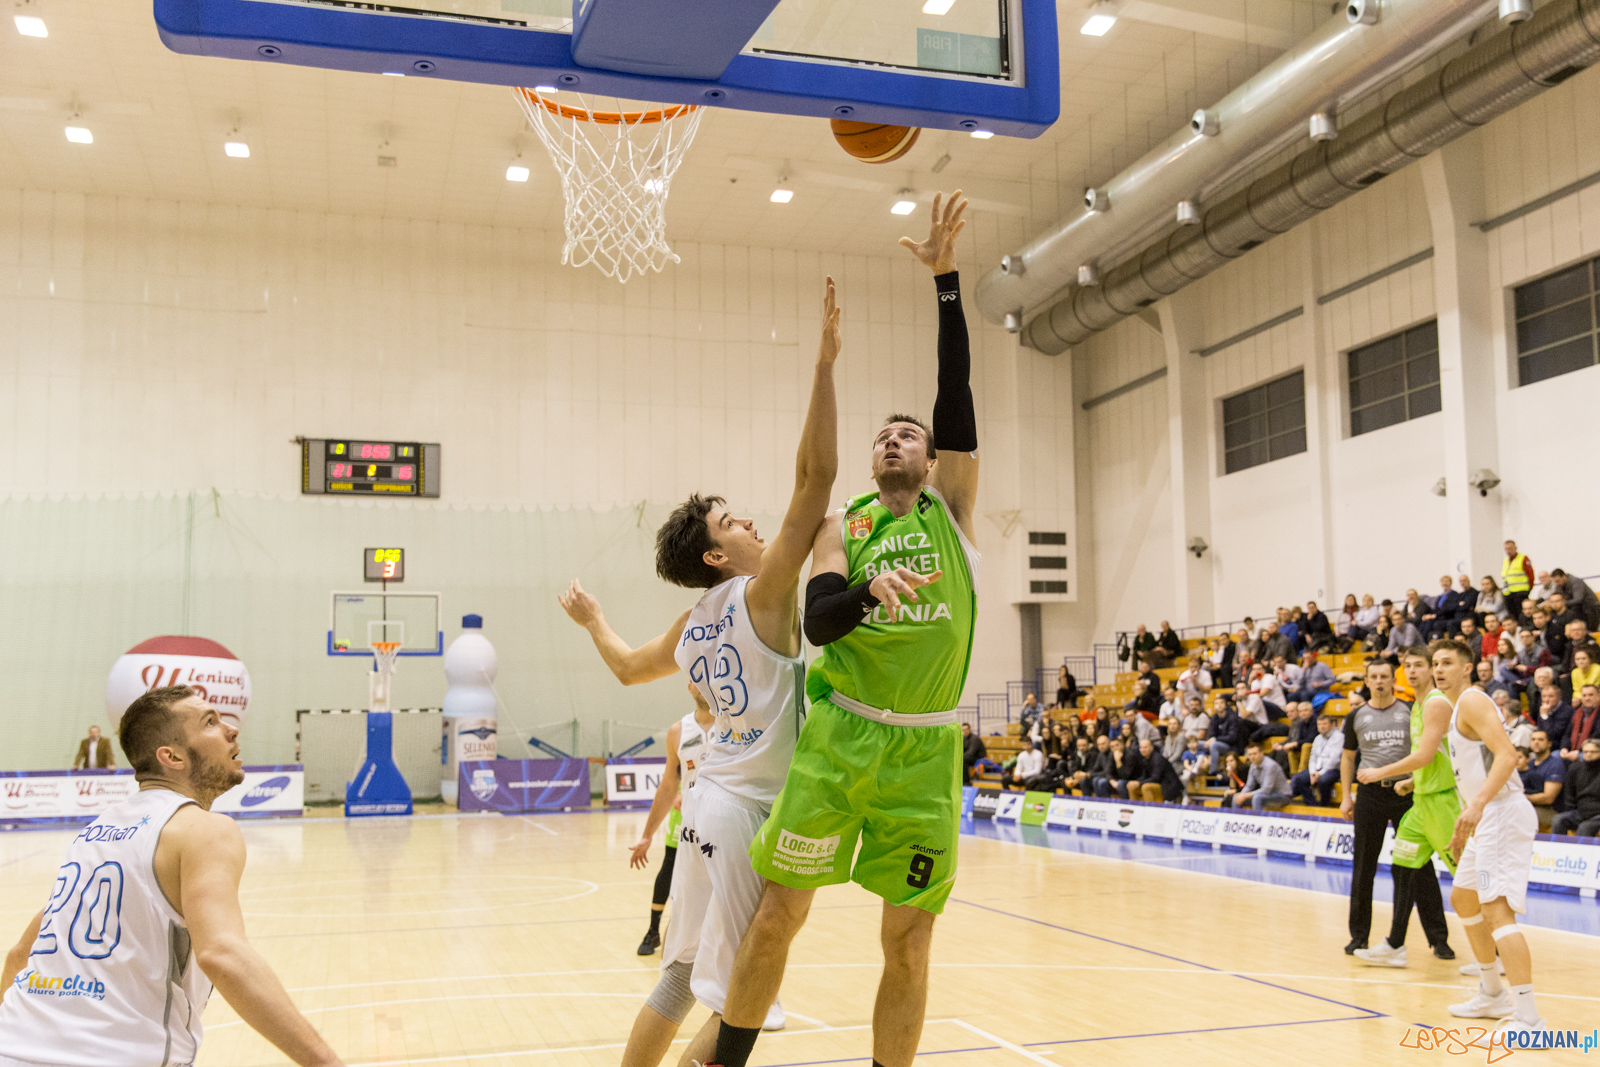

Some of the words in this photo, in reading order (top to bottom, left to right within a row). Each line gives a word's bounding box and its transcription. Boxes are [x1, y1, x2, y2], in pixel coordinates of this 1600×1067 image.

[333, 463, 353, 478] 21
[871, 533, 931, 560] ZNICZ
[383, 560, 397, 578] 3
[865, 553, 940, 581] BASKET
[1363, 730, 1405, 742] VERONI
[1223, 821, 1262, 836] BIOFARM
[1267, 825, 1311, 841] BIOFARM
[782, 835, 815, 854] LOGO
[773, 851, 815, 865] profesjonalna
[906, 853, 935, 889] 9
[30, 861, 124, 960] 20
[27, 987, 55, 996] biuro
[28, 972, 105, 994] funclub
